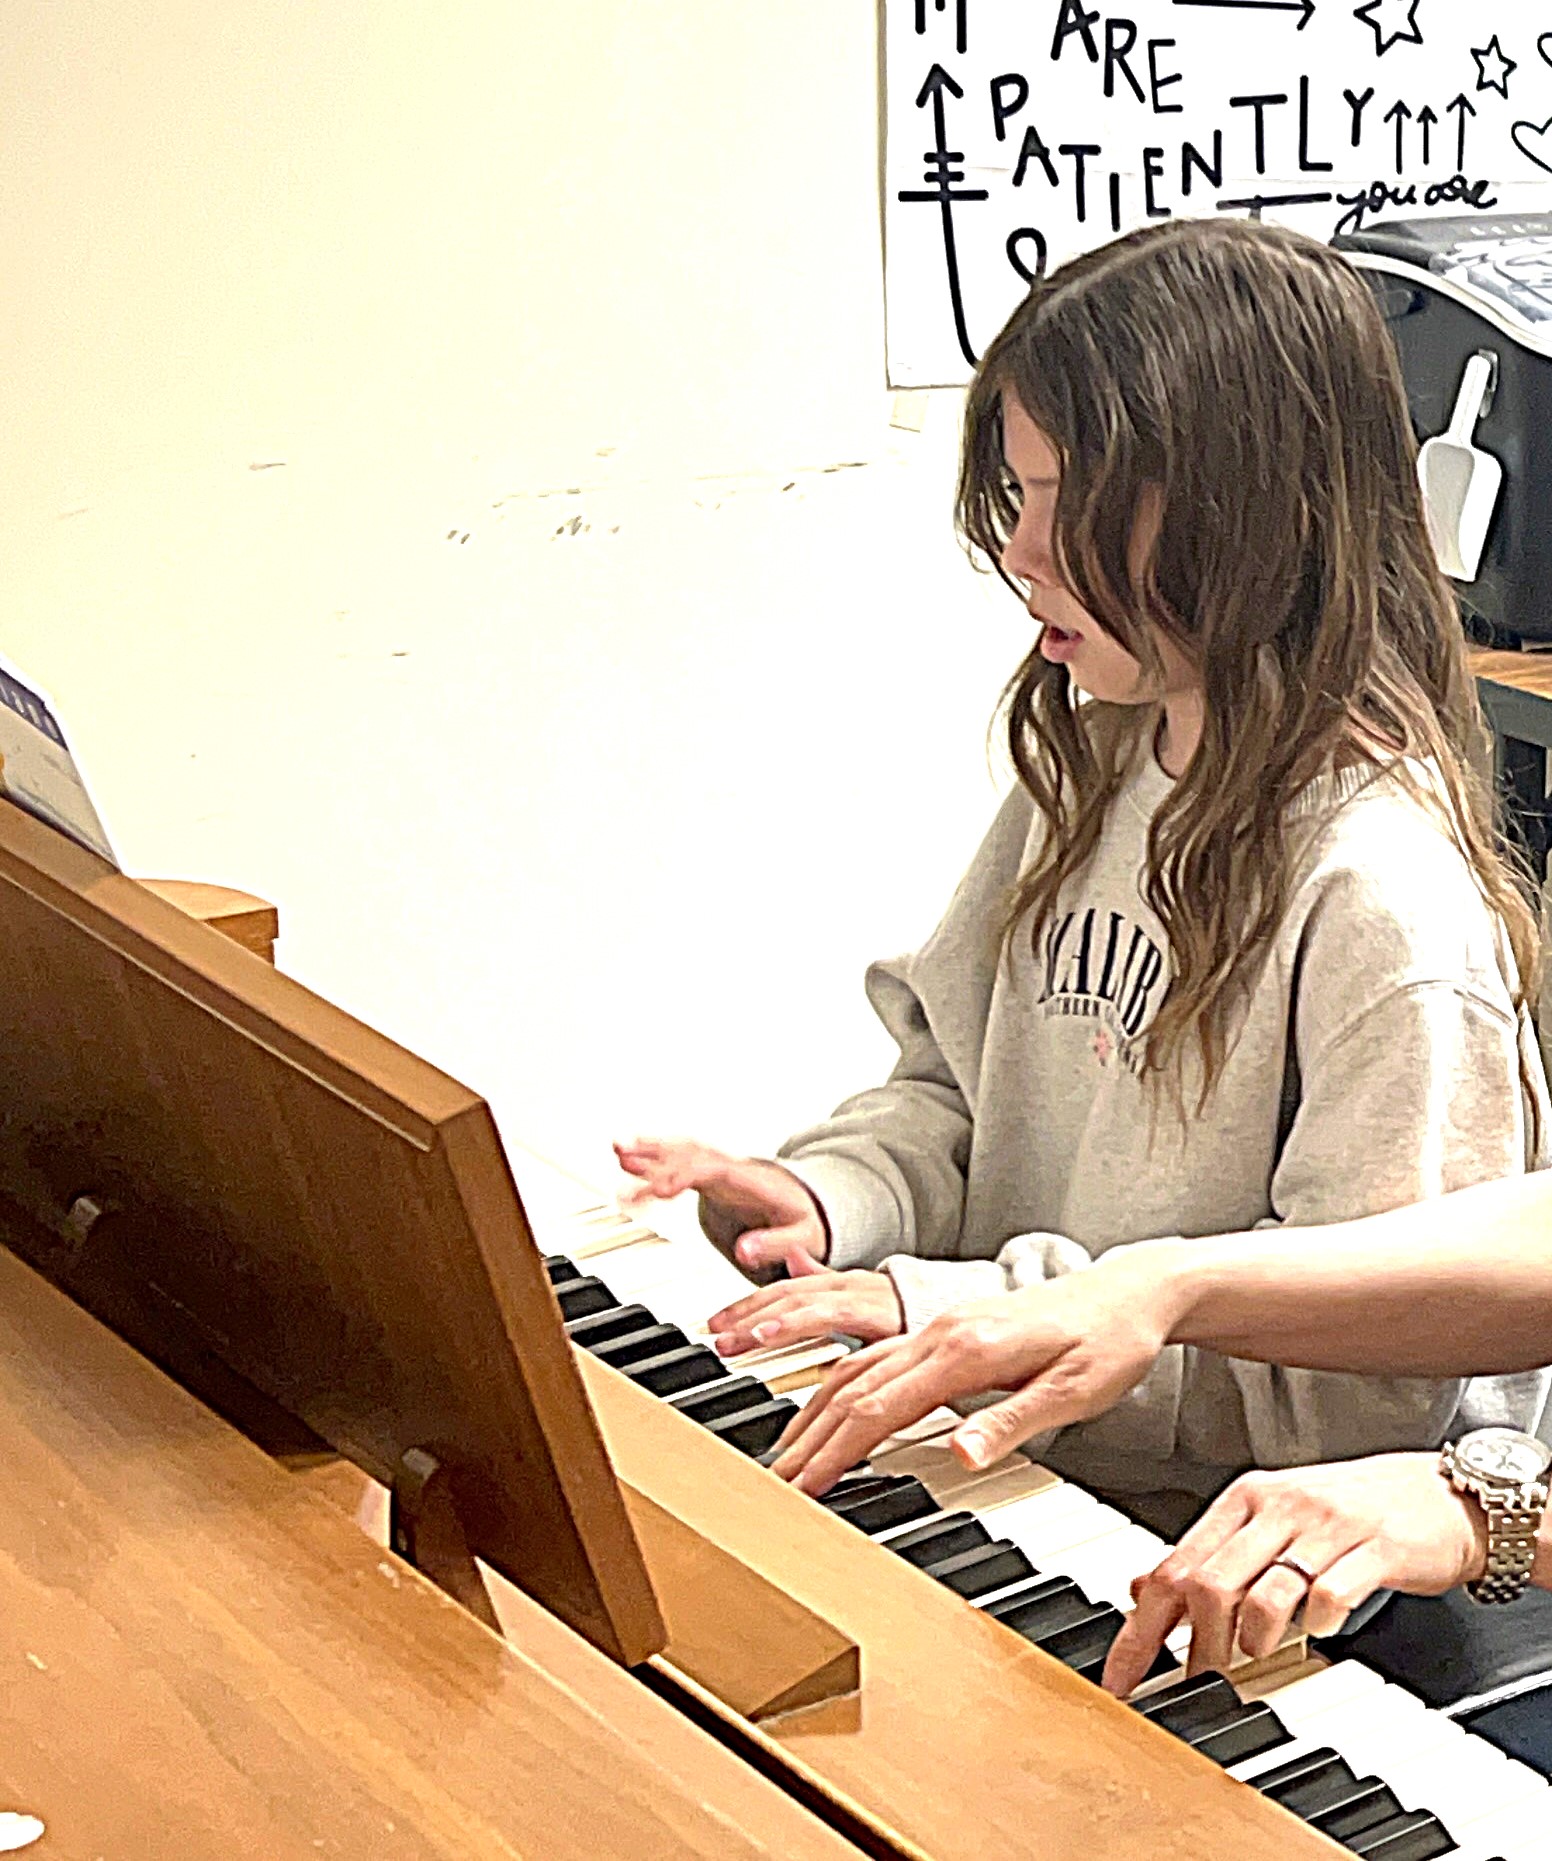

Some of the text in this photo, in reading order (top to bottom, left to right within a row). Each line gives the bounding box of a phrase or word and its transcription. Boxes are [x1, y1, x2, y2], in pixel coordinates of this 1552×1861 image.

[1049, 0, 1183, 114] ARE
[989, 72, 1374, 232] PATIENTLY
[1334, 180, 1417, 236] you
